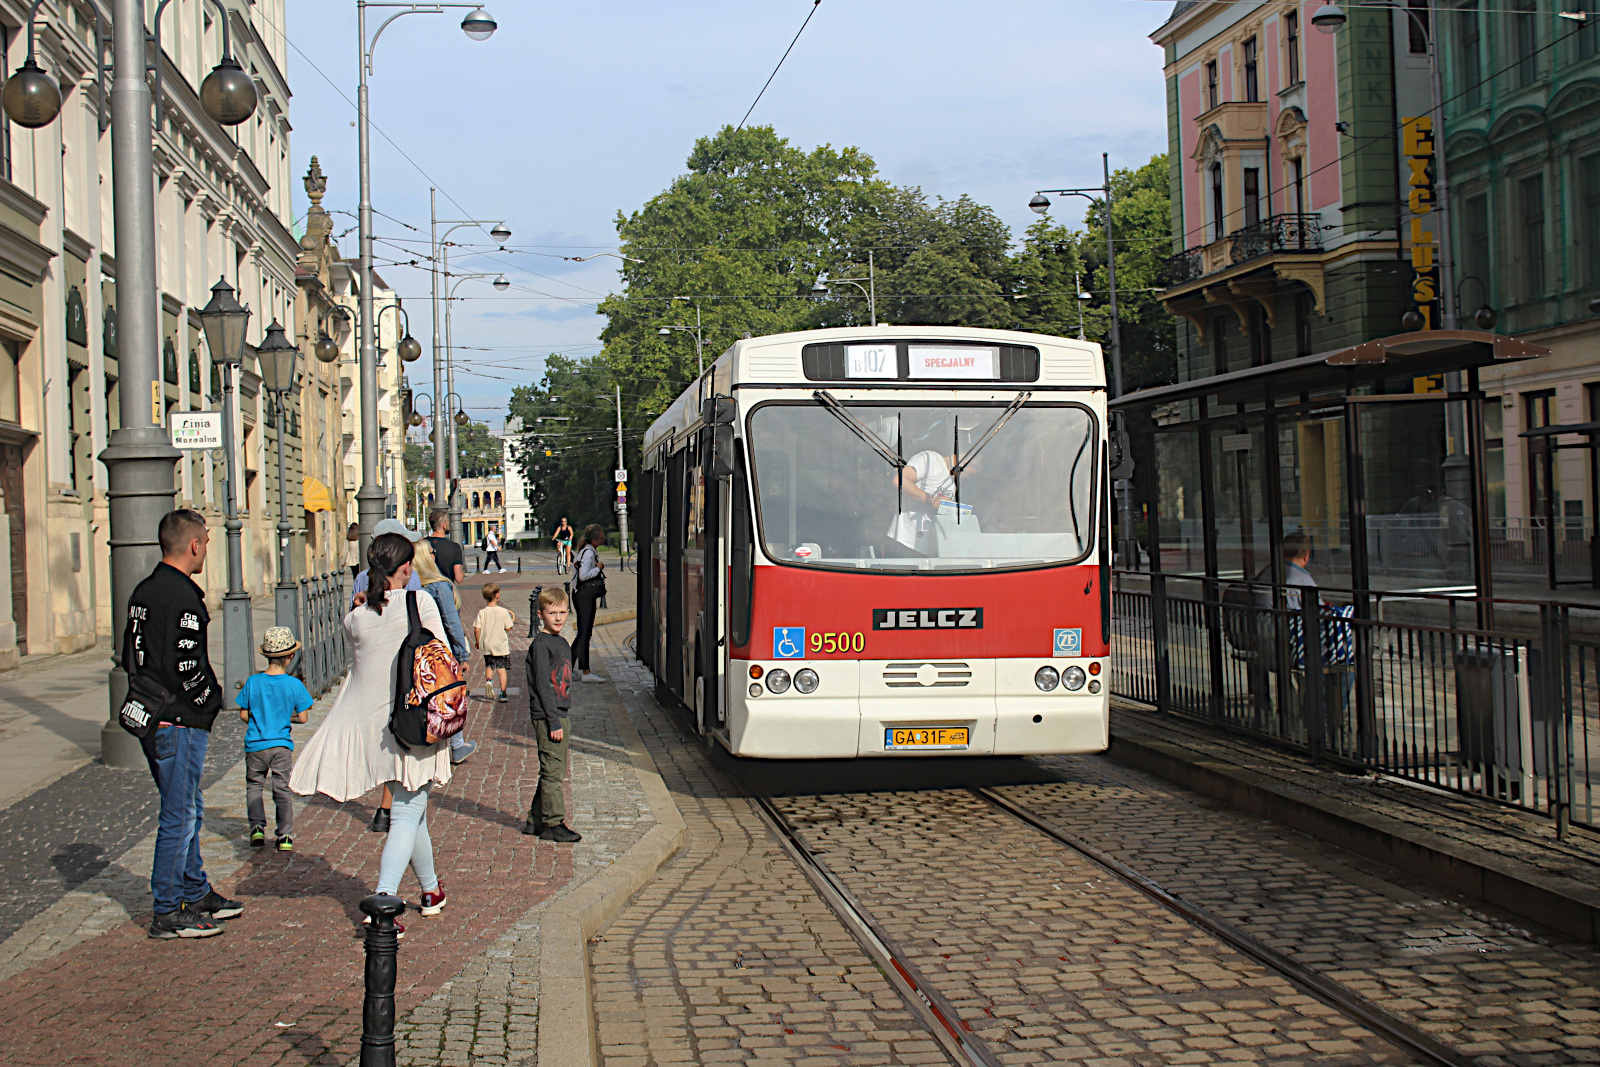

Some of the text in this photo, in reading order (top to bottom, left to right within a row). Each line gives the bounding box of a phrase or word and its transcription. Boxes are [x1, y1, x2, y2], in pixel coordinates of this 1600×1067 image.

[1402, 116, 1443, 394] EXCLUSIE
[924, 357, 975, 368] SPECJALNY
[182, 418, 211, 429] Linia
[175, 435, 217, 444] Muzealna
[879, 609, 978, 628] JELCZ
[810, 631, 866, 653] 9500
[895, 730, 947, 744] GA 31F
